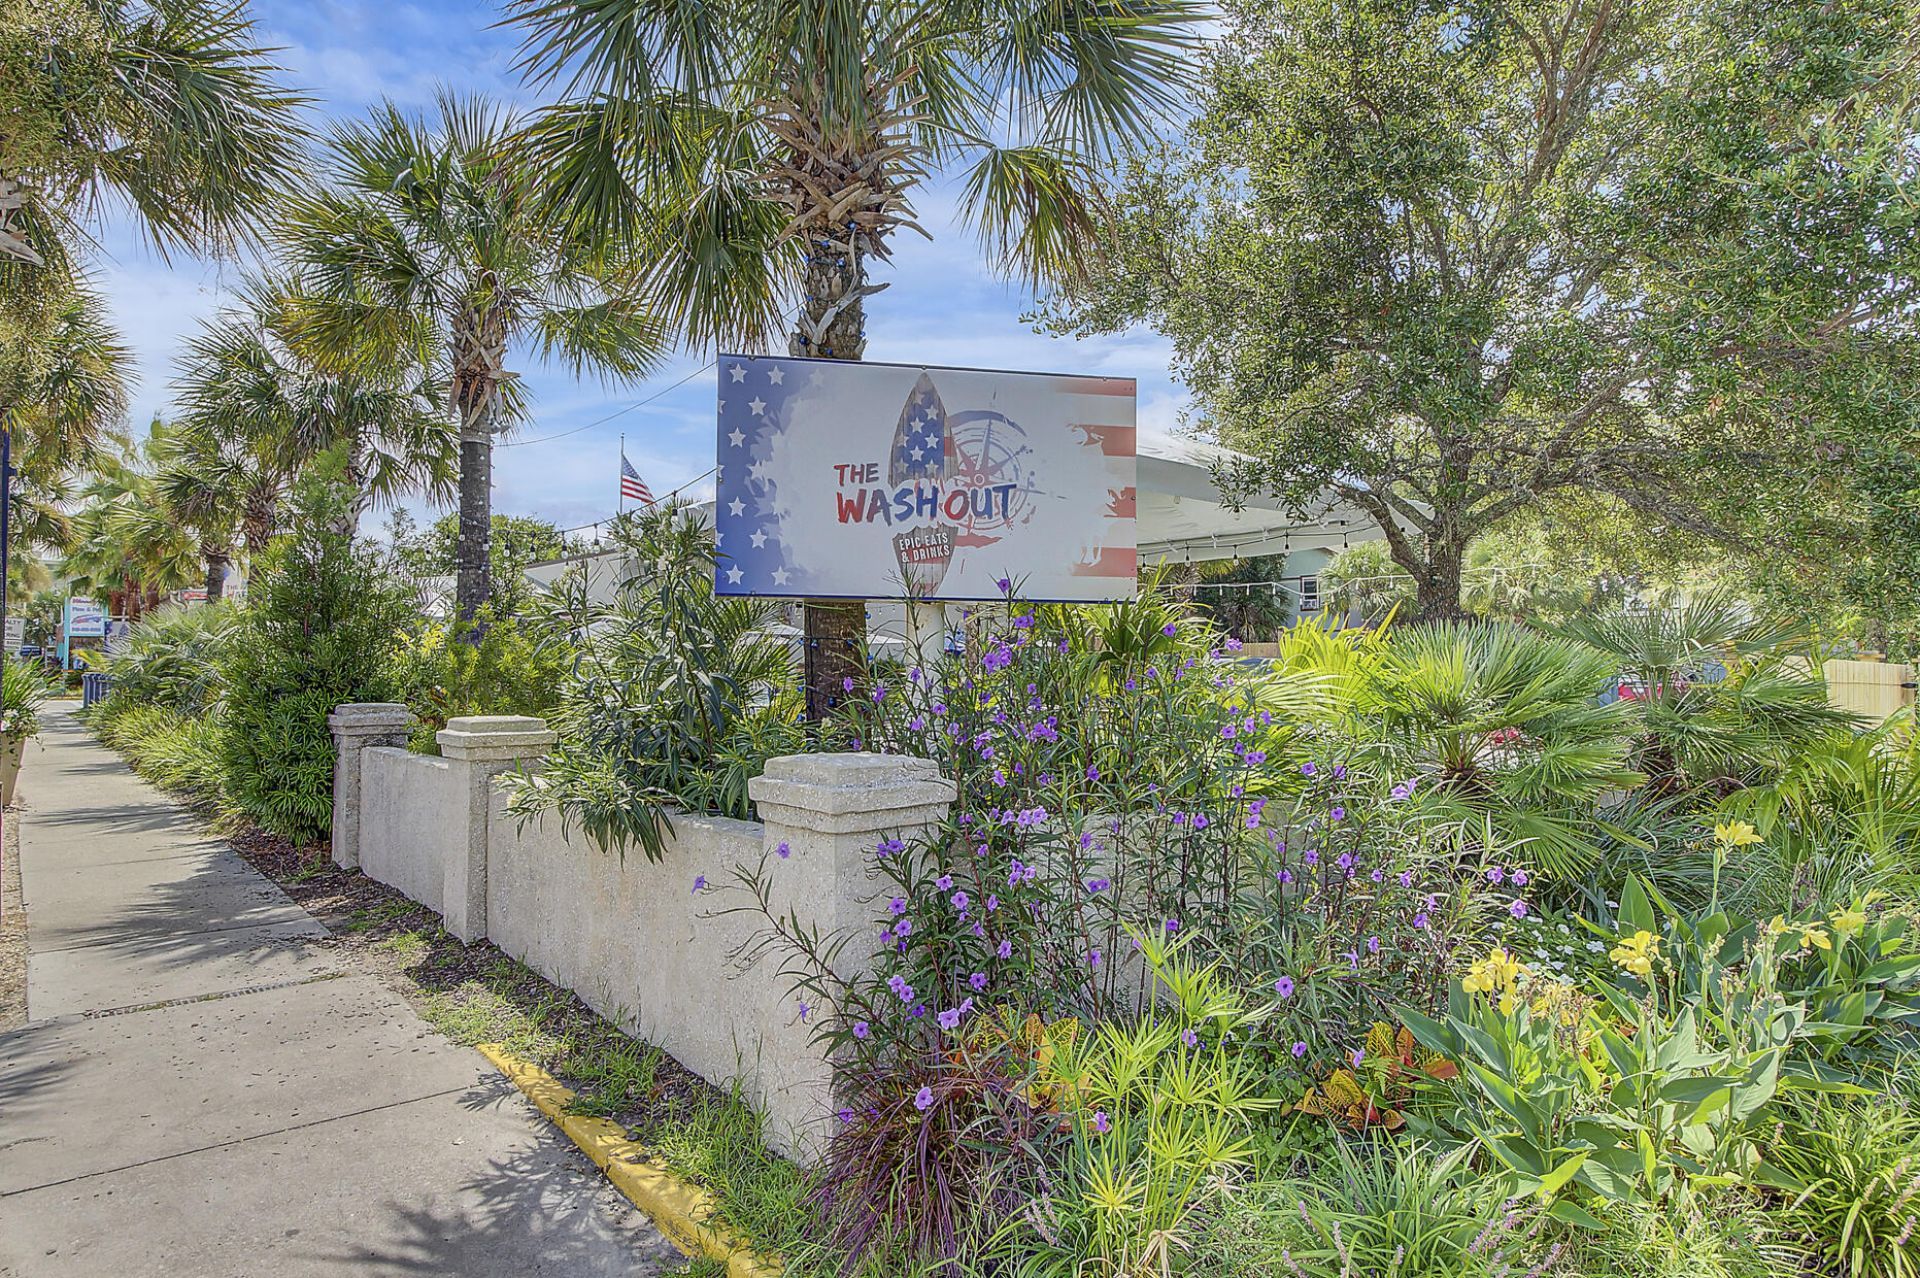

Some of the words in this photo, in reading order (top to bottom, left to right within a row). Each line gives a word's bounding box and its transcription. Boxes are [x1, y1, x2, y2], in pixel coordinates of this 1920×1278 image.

[833, 463, 879, 487] THE
[837, 483, 1017, 526] WASHOUT
[899, 536, 921, 550] EPIC
[925, 532, 948, 546] EATS
[901, 551, 910, 563] &
[912, 545, 950, 561] DRINKS
